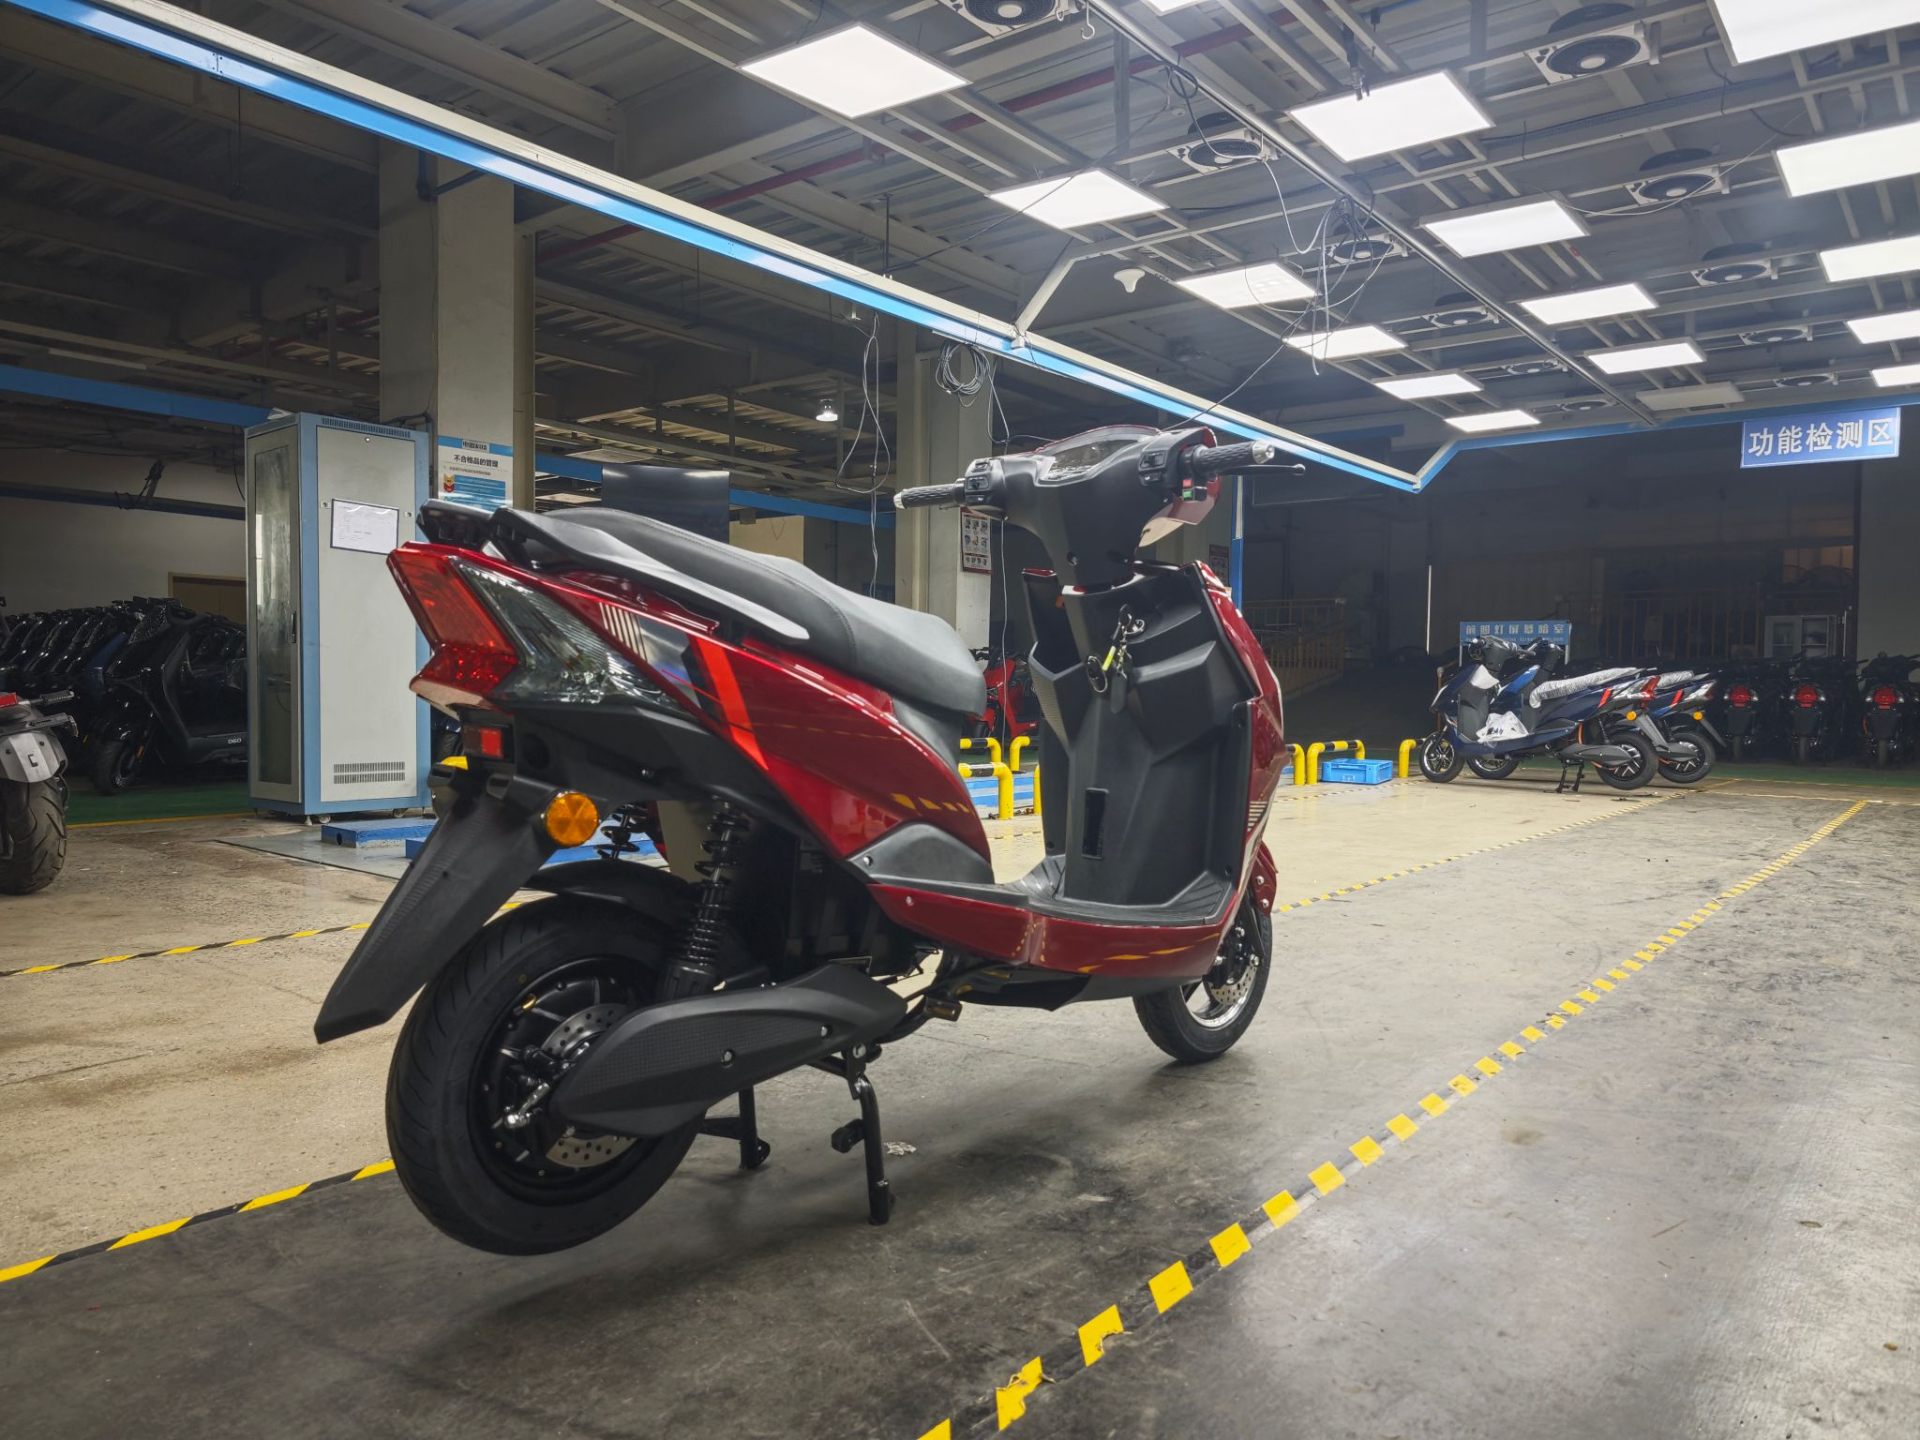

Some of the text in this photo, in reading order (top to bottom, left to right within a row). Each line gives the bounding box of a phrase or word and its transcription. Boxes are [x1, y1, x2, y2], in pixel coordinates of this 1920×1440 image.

[1748, 417, 1893, 457] 功能检测区
